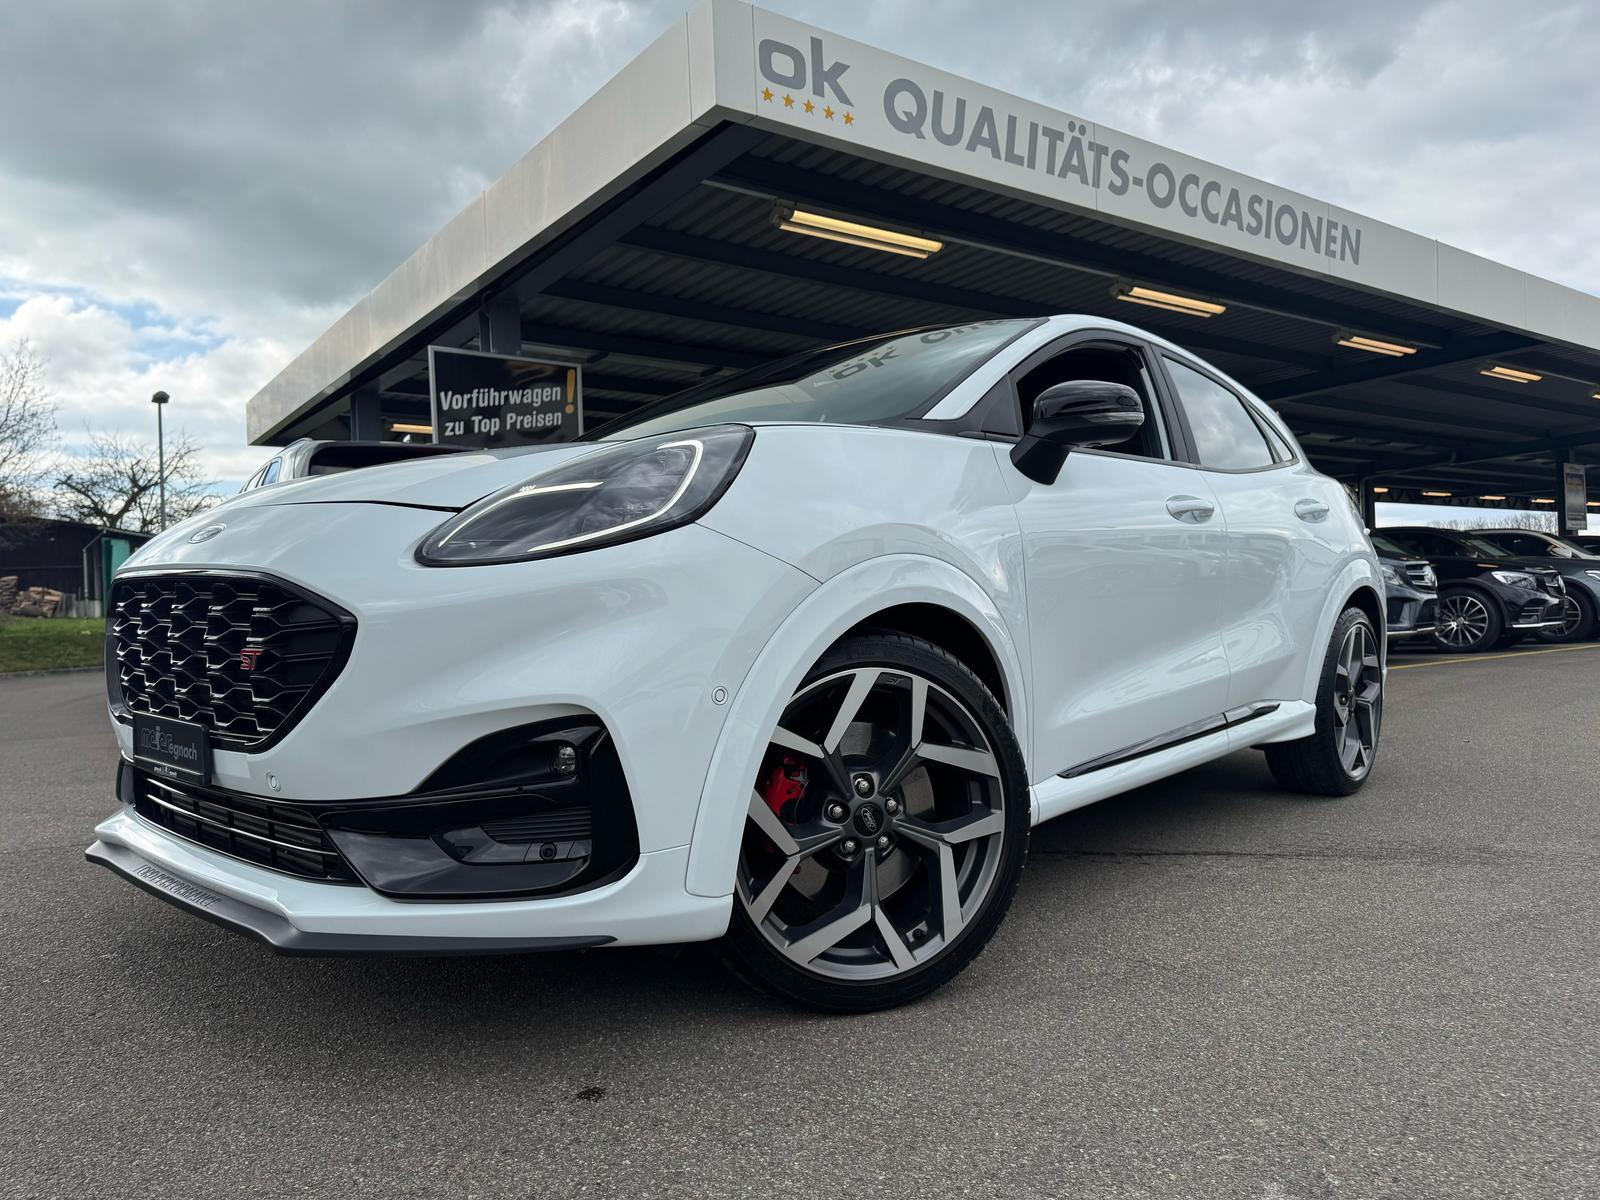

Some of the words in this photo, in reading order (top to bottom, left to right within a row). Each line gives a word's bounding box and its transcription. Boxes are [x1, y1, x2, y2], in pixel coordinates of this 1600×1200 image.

[758, 36, 855, 107] ok
[883, 78, 1361, 265] QUALITÄTS-OCCASIONEN
[440, 386, 561, 411] Vorführwagen
[444, 420, 465, 436] zu
[471, 415, 500, 436] Top
[506, 410, 562, 430] Preisen
[240, 648, 264, 670] ST
[168, 742, 197, 760] egnach
